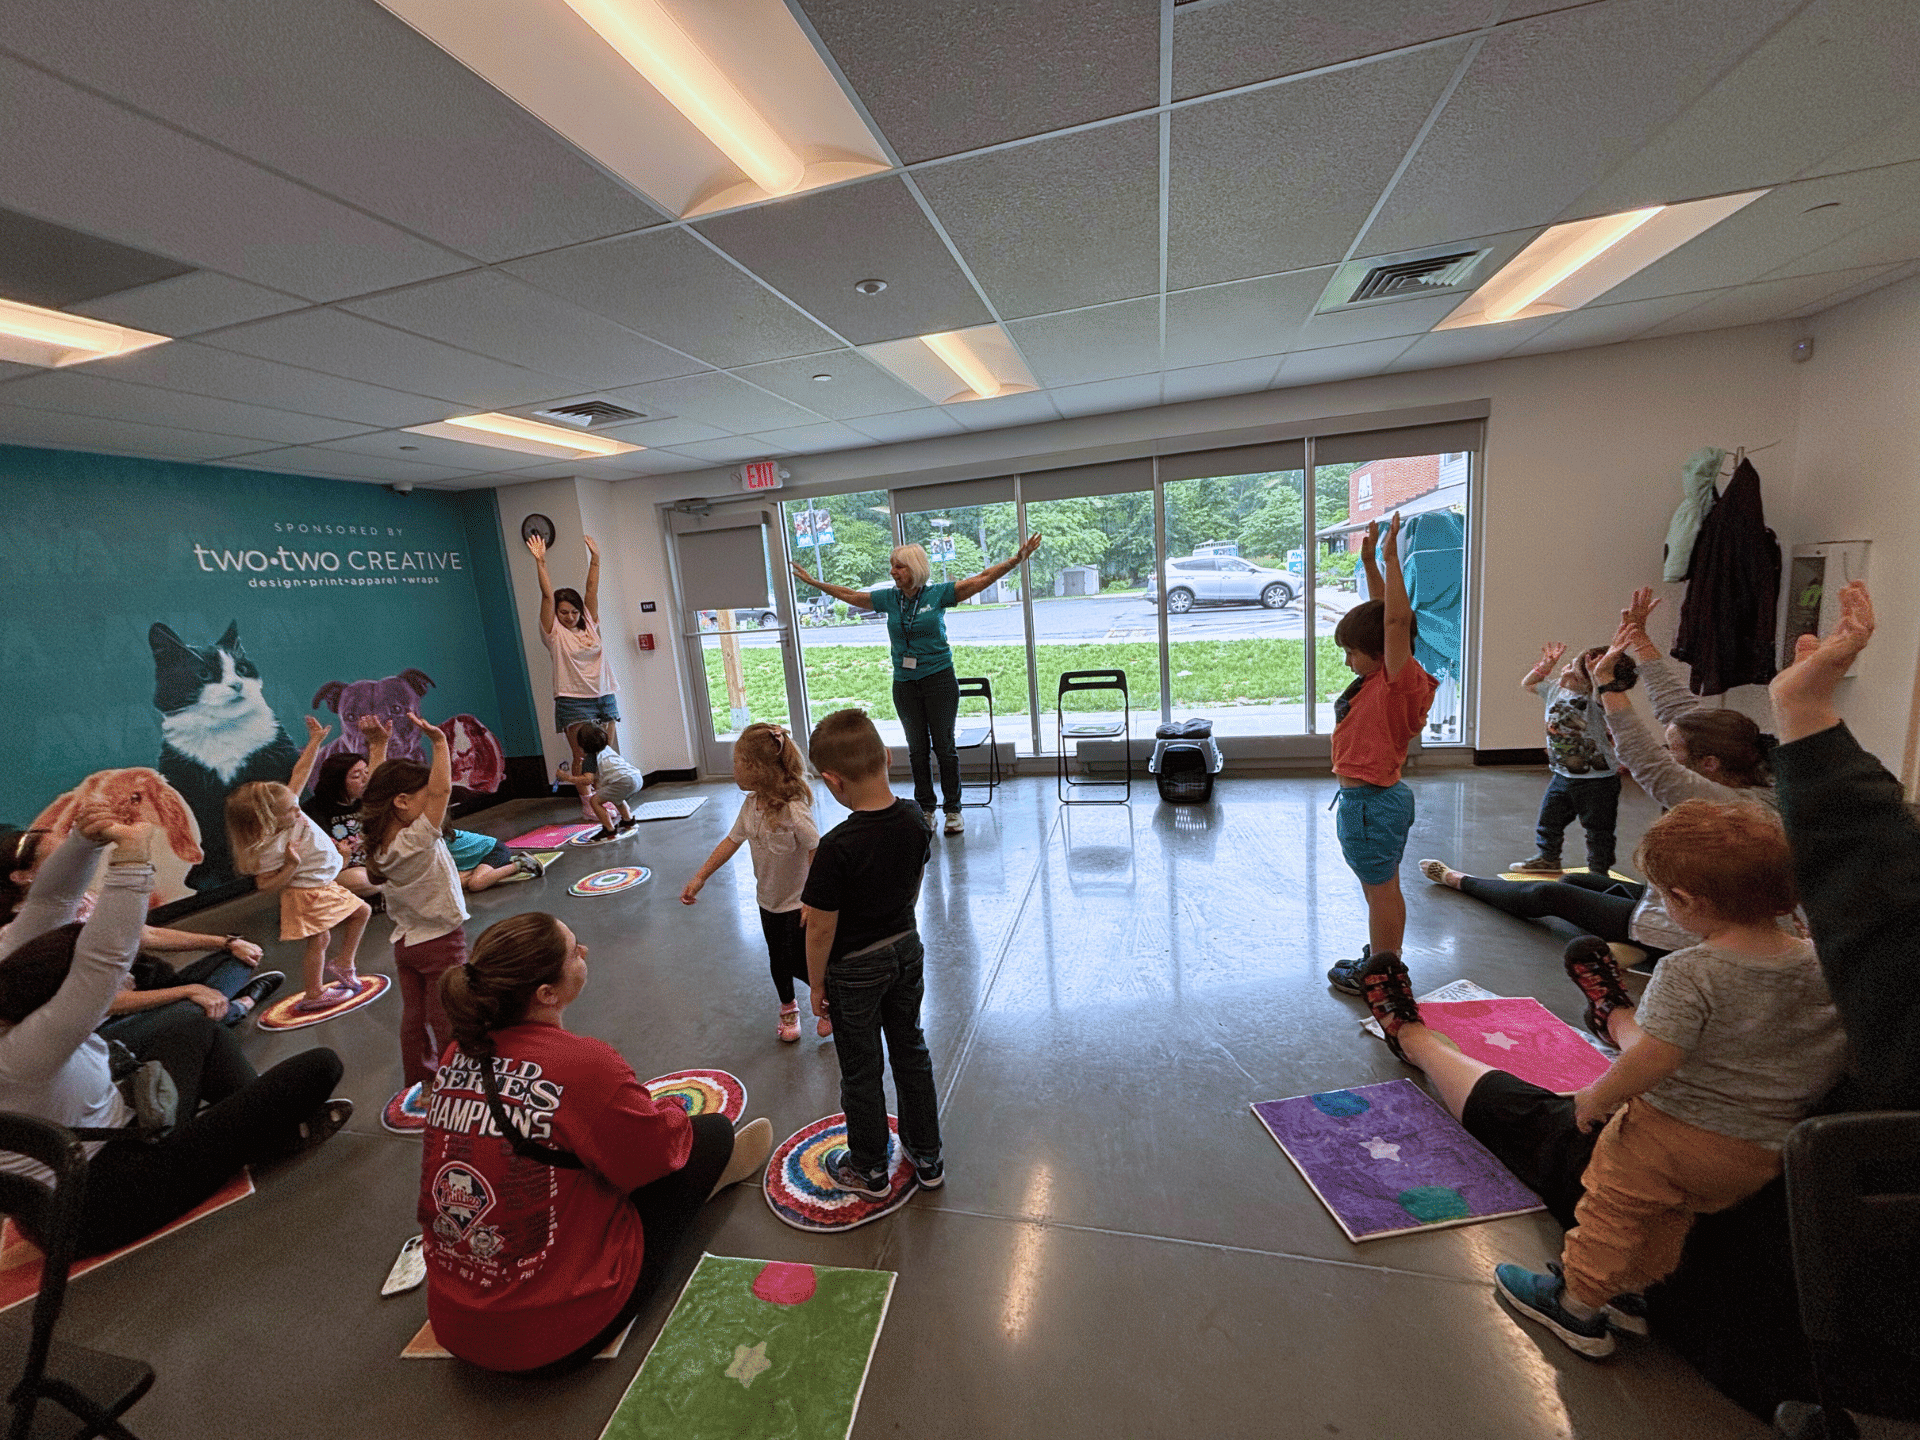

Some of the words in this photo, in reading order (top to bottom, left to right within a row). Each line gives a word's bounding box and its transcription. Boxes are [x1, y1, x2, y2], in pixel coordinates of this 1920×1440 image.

[746, 462, 774, 489] EXIT
[274, 522, 378, 536] SPONSORED
[387, 527, 402, 536] BY
[347, 550, 462, 571] CREATIVE
[432, 1065, 564, 1111] SERES
[427, 1094, 554, 1139] HAMPIONS
